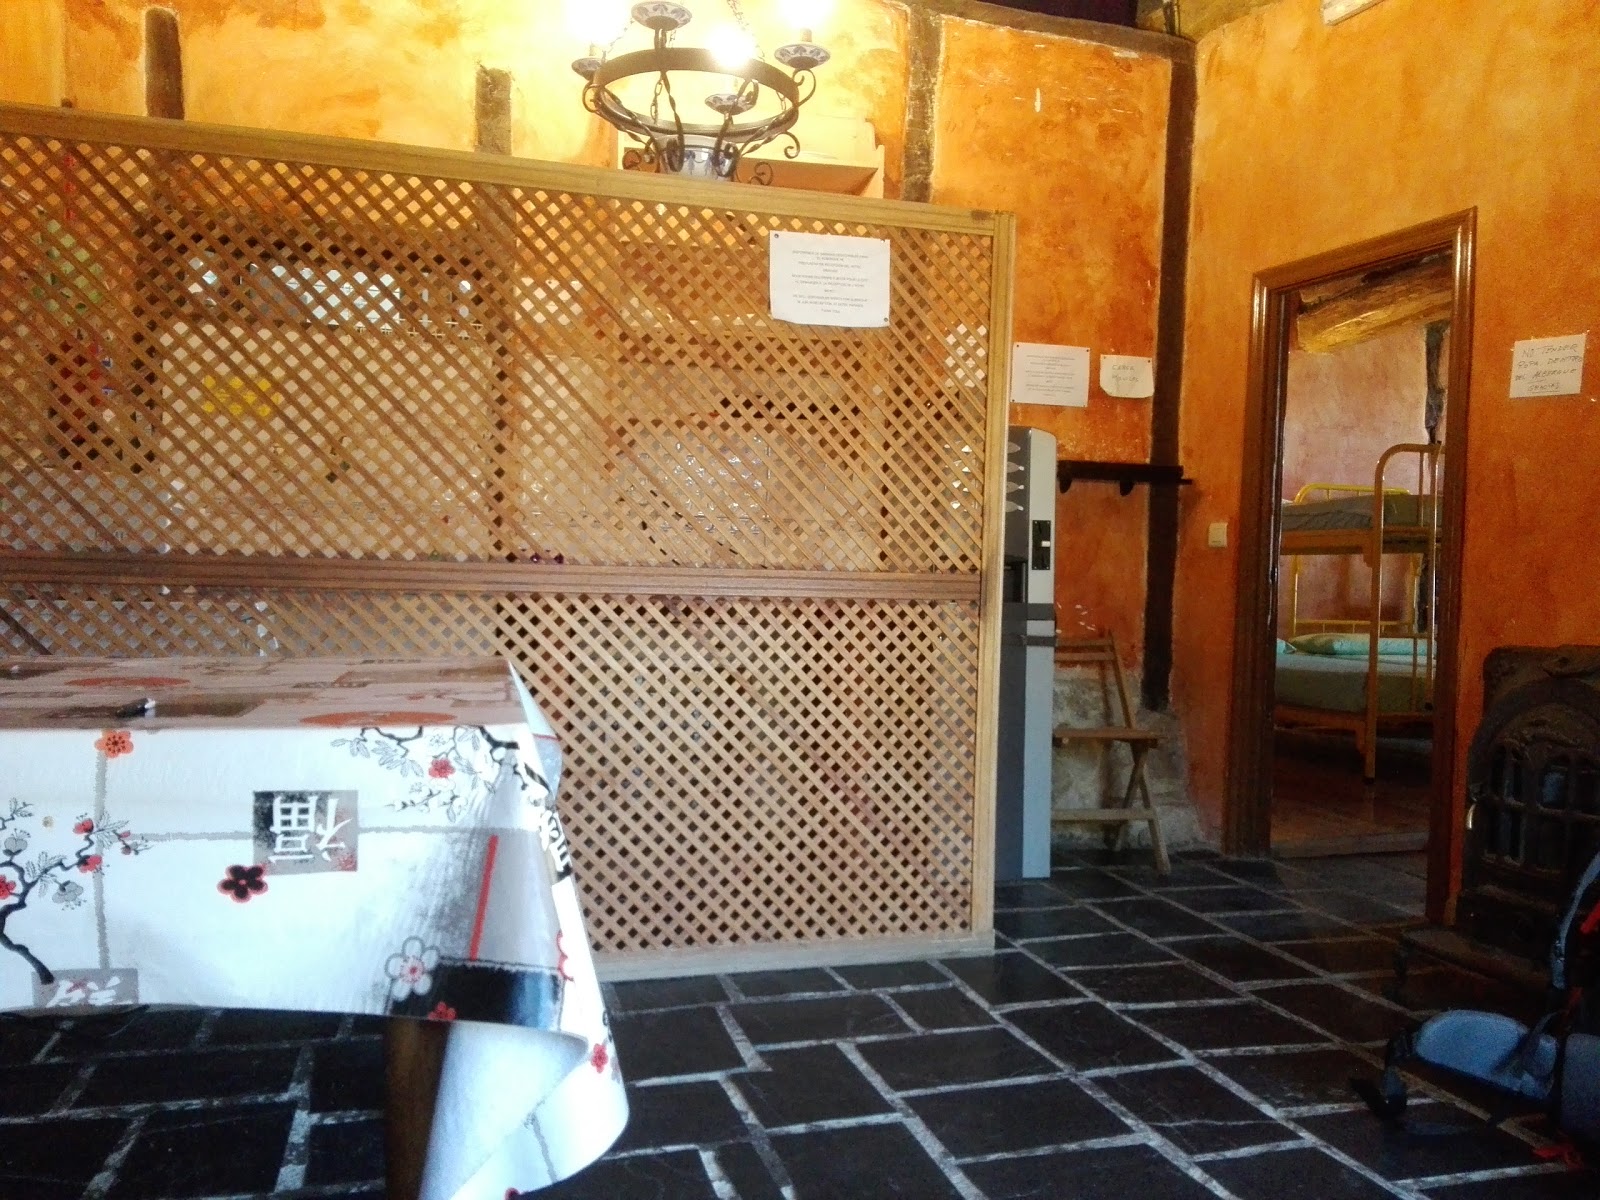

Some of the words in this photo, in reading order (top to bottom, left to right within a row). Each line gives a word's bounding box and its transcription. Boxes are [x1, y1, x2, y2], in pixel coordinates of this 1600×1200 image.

[1522, 348, 1534, 358] NO
[1537, 344, 1577, 354] TENDER
[1547, 356, 1582, 364] DENTRO
[1532, 368, 1577, 379] ALBERGUE
[1528, 383, 1560, 391] GRACIAS
[267, 795, 353, 864] 福
